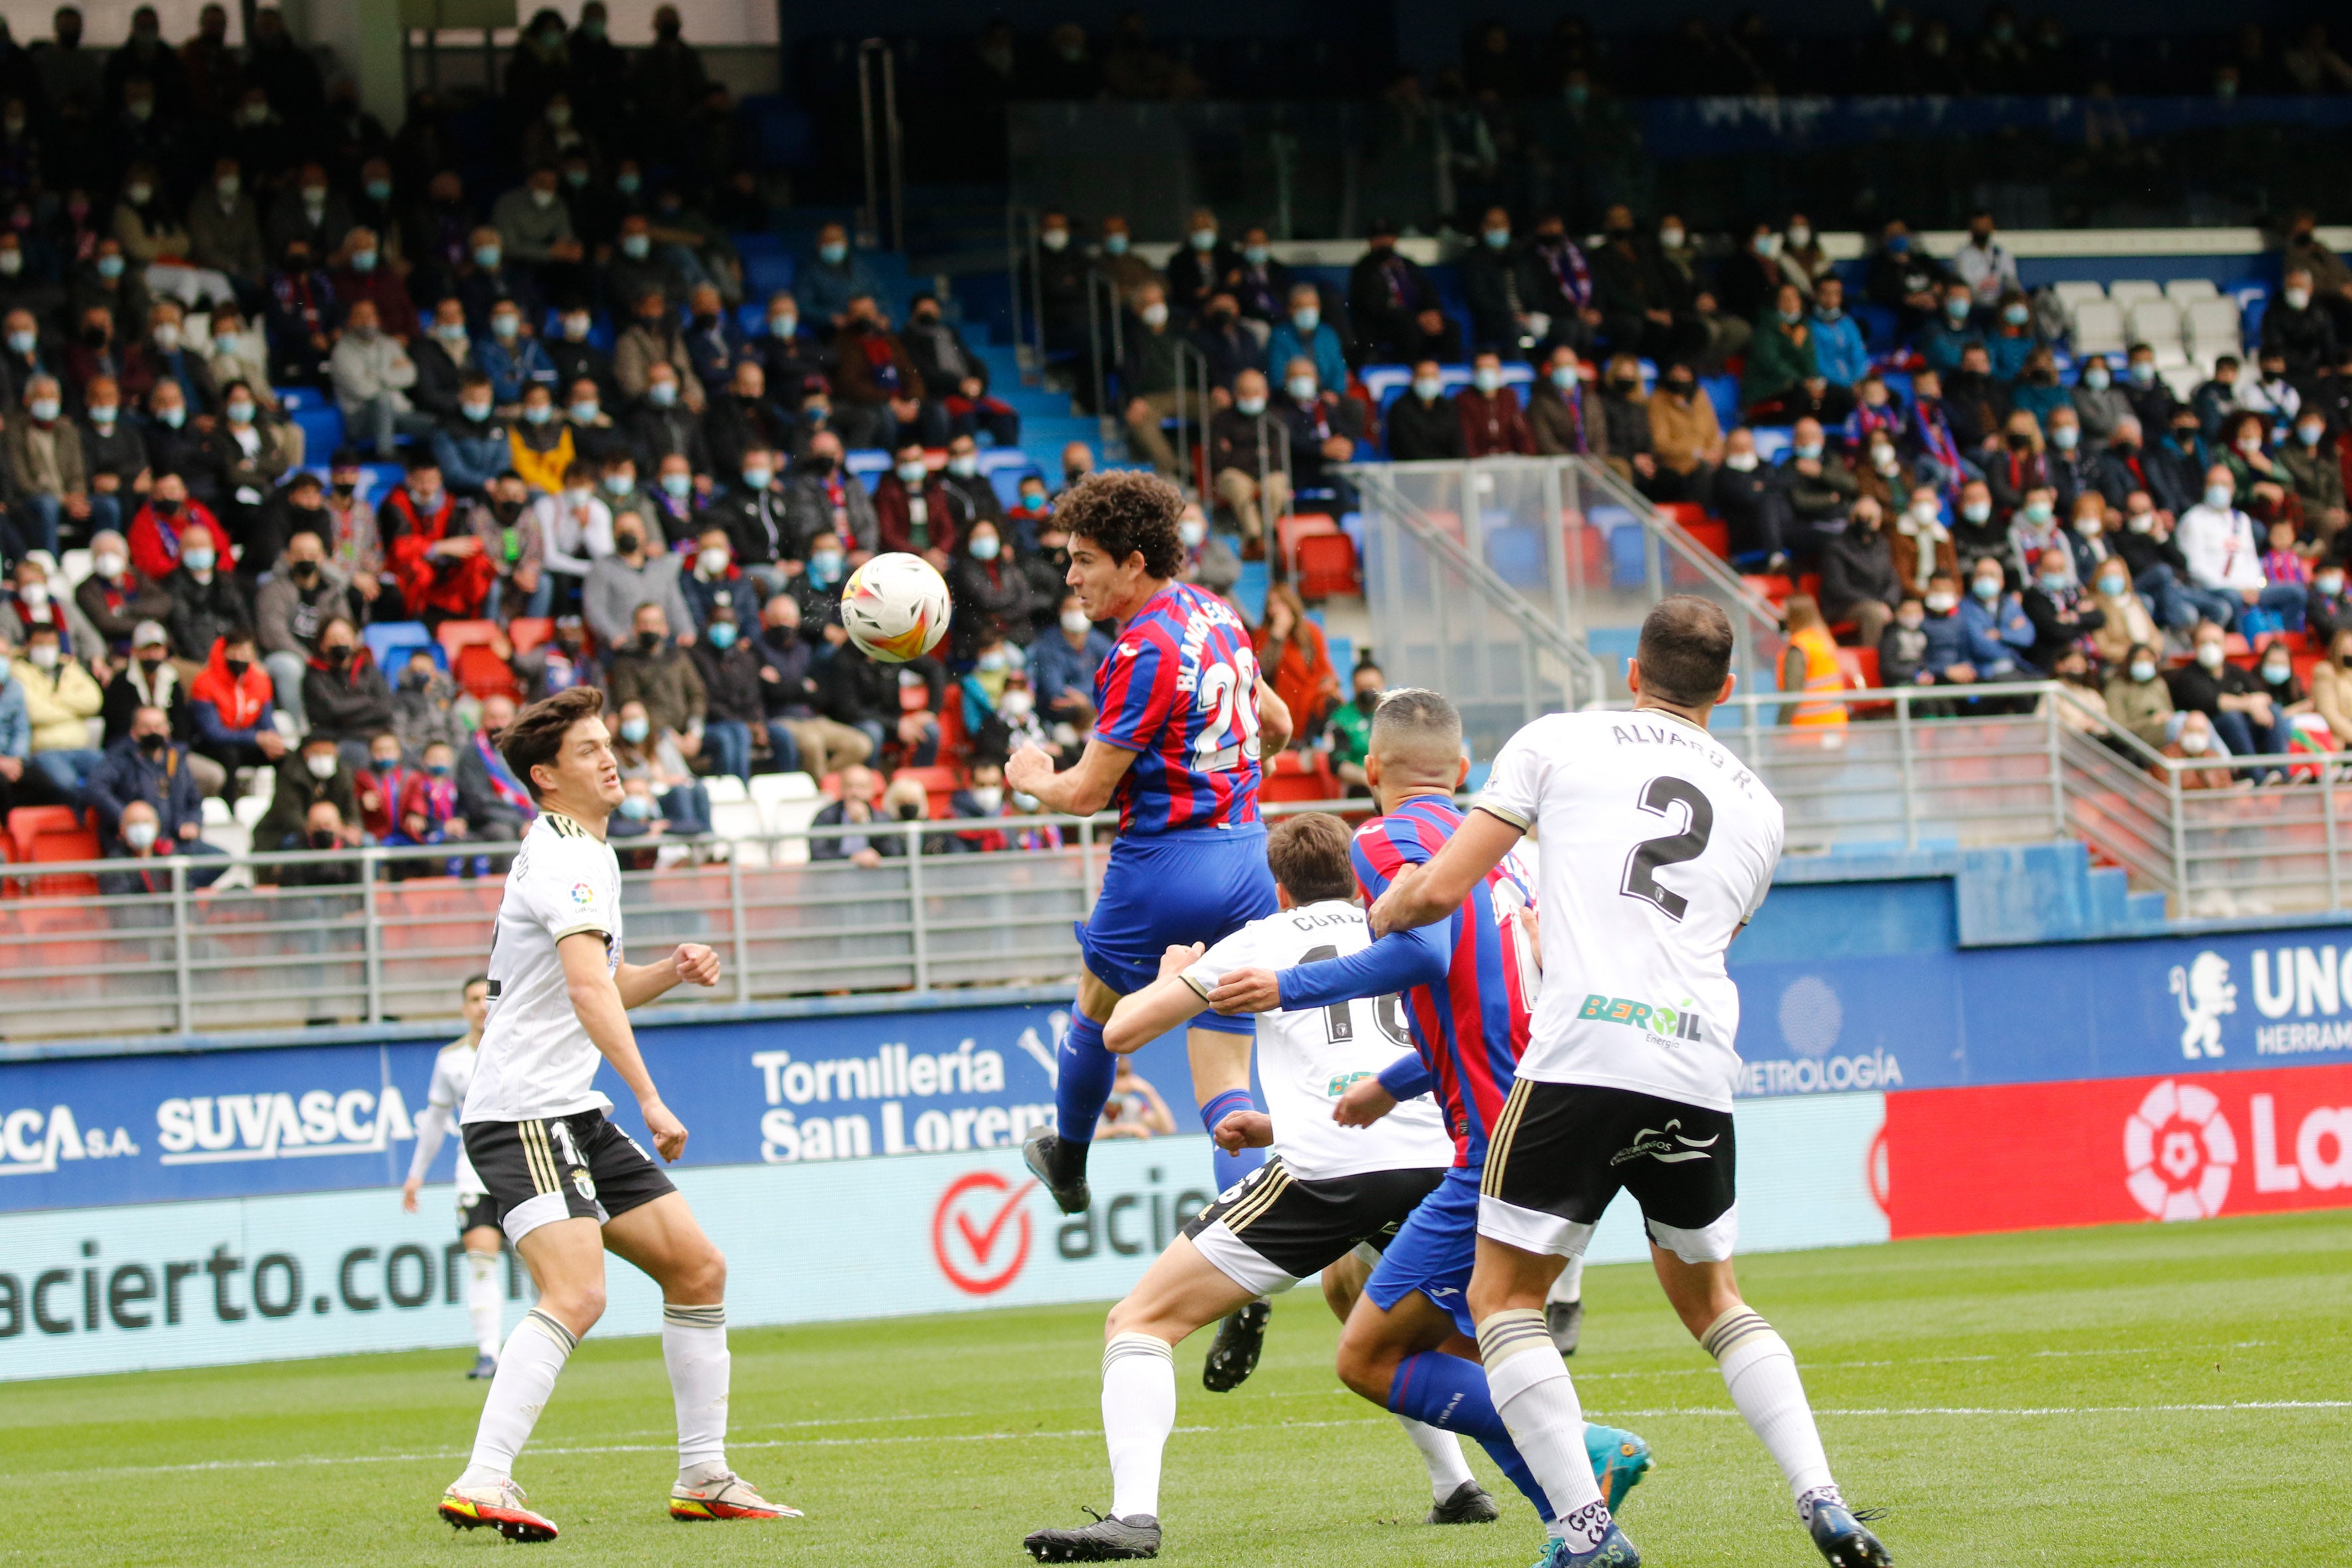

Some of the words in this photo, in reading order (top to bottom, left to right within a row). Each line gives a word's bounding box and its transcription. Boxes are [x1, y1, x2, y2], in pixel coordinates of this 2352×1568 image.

[1190, 647, 1261, 771] 20
[1620, 775, 1713, 924] 2
[156, 1085, 414, 1163] SUVASCA
[761, 1107, 872, 1163] San
[2249, 1092, 2352, 1194] La
